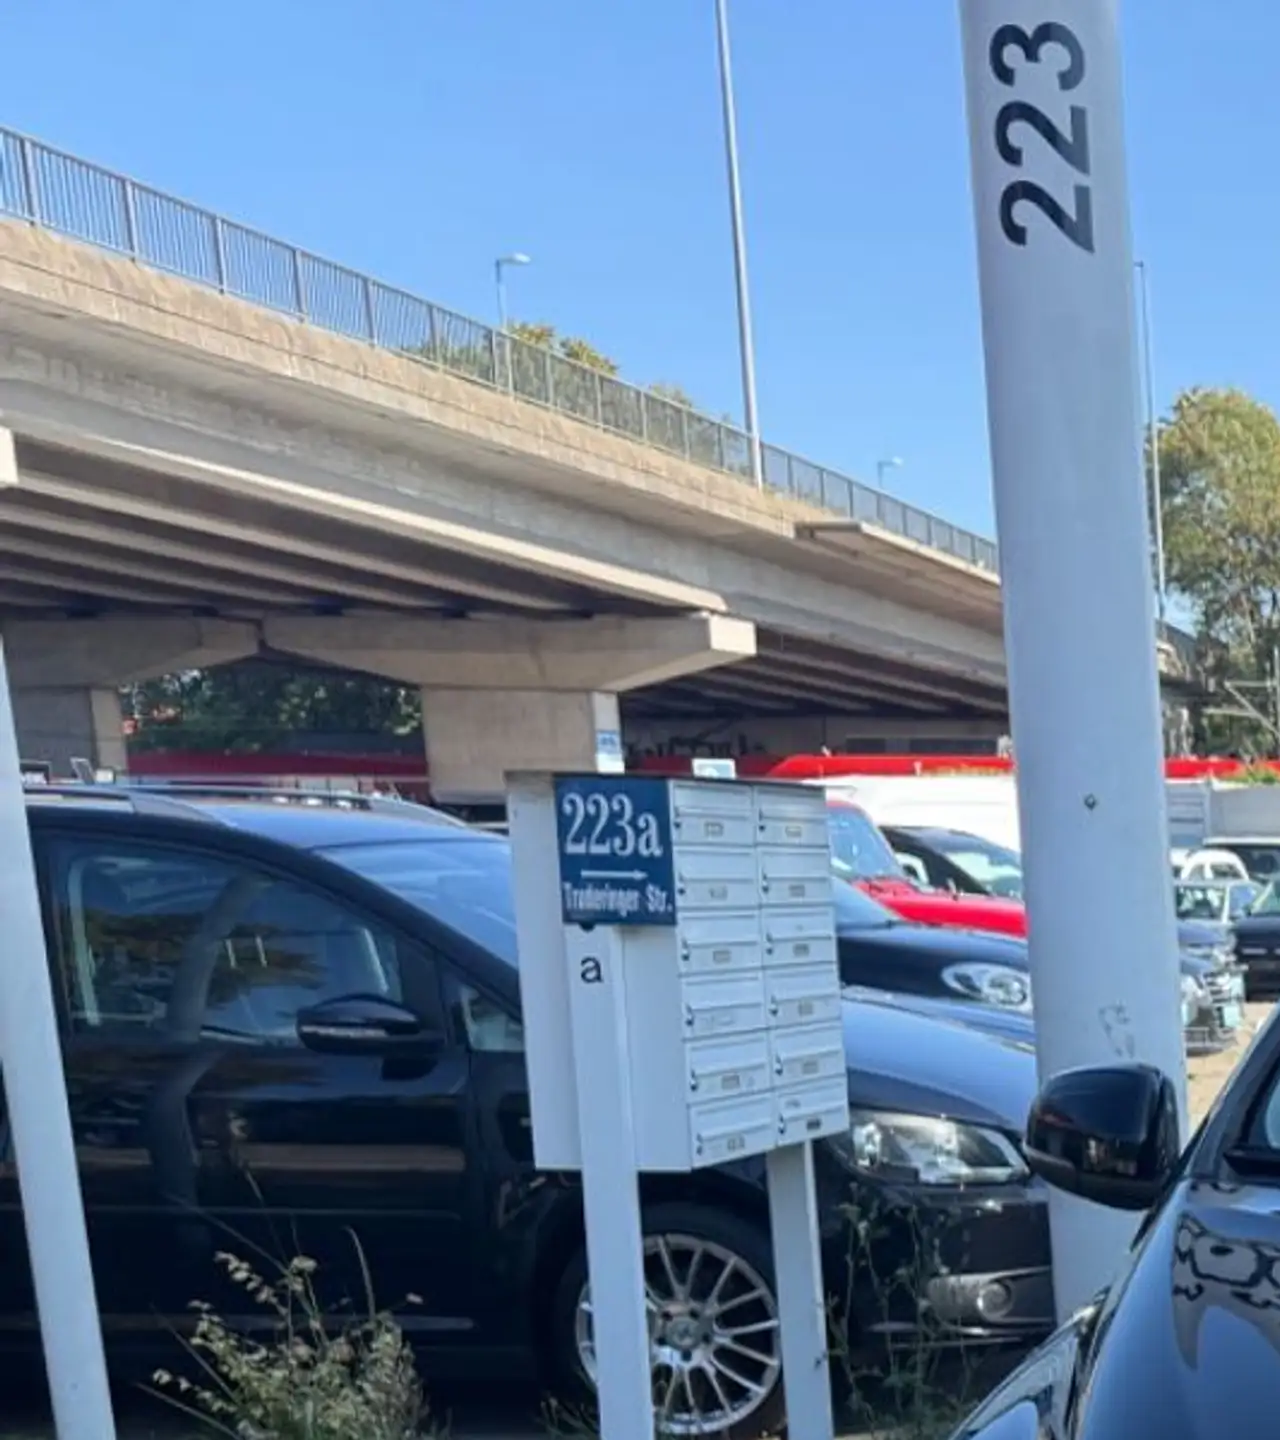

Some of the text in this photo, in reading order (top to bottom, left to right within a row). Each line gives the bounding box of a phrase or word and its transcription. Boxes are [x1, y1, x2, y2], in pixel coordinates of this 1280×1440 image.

[988, 21, 1096, 254] 223
[562, 792, 664, 858] 223a
[580, 956, 604, 984] a
